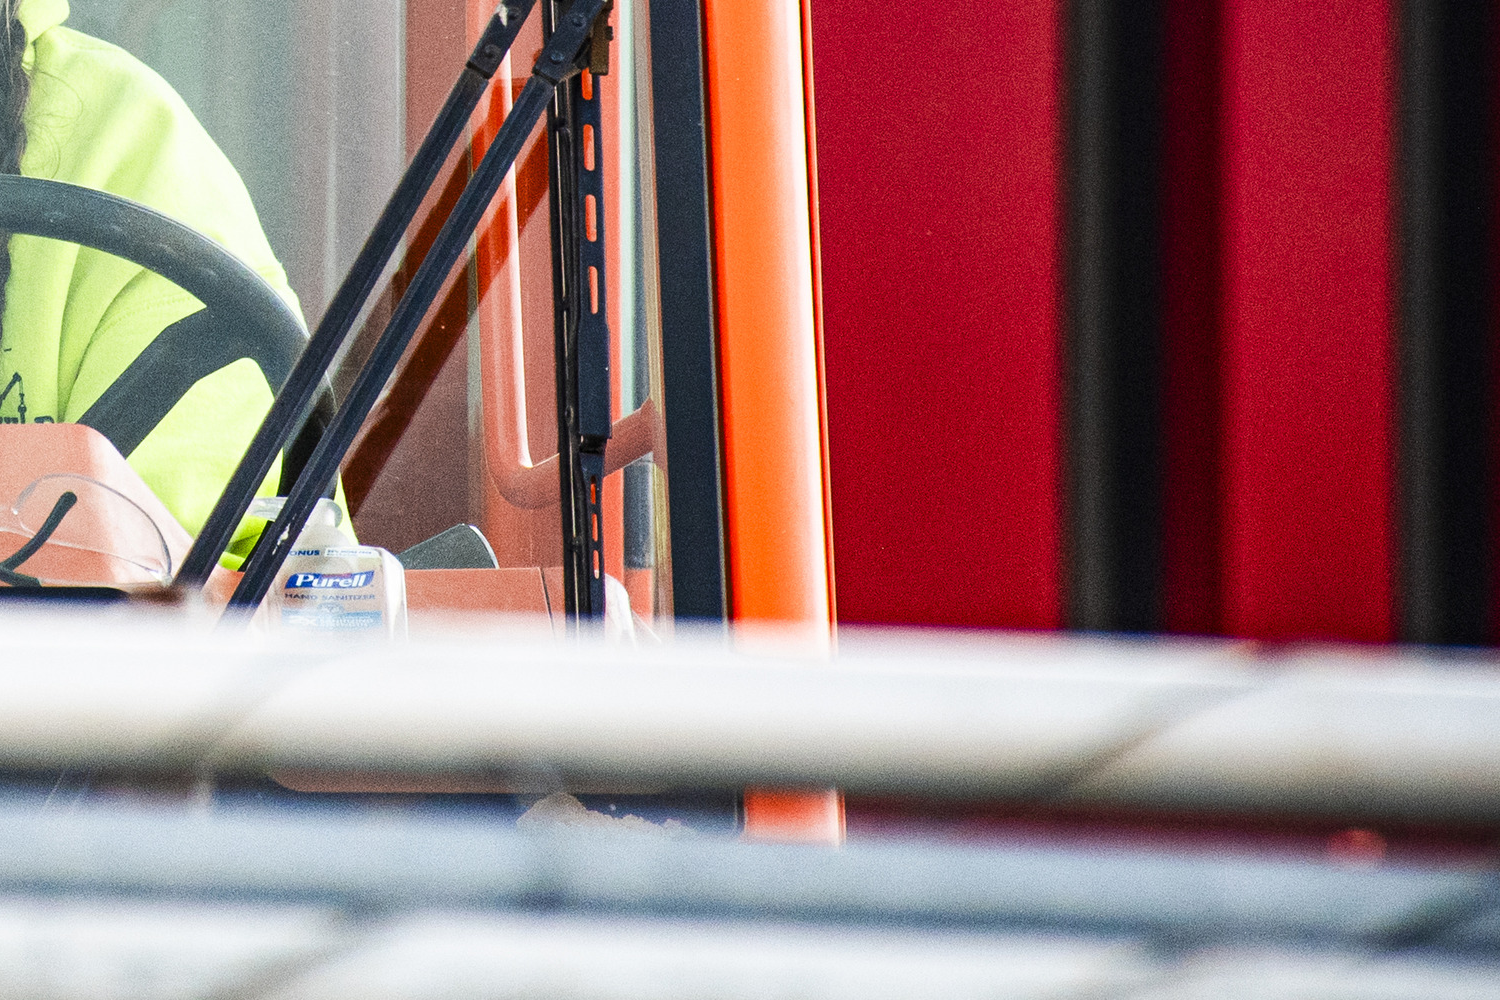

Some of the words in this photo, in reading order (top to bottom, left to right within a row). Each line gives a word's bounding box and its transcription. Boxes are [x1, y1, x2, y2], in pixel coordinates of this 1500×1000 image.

[295, 573, 367, 588] Purell
[284, 593, 318, 601] HAND
[321, 593, 376, 601] SANITIZER
